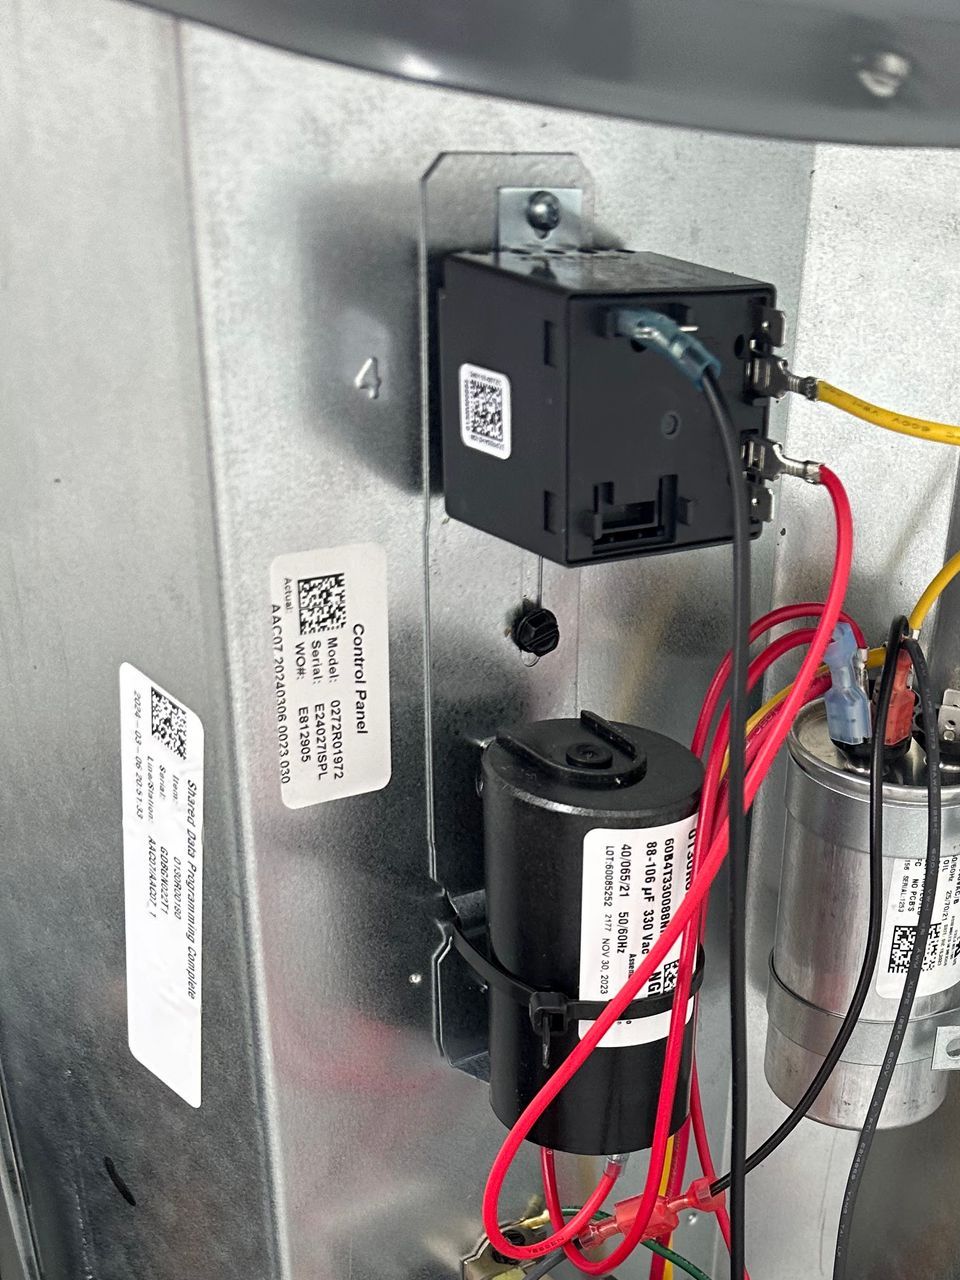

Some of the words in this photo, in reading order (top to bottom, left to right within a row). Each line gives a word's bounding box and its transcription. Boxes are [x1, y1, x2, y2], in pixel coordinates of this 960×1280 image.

[295, 642, 307, 680] WO#:
[311, 640, 323, 685] Serial:
[327, 637, 339, 684] Model:
[352, 623, 366, 684] Control
[355, 689, 368, 734] Panel
[299, 707, 311, 763] E812905
[330, 699, 344, 780] 0272R01972
[187, 779, 197, 827] Shared
[187, 829, 196, 858] Data
[645, 841, 657, 883] 88-106
[619, 844, 631, 897] 40/065/21
[911, 879, 918, 889] NO
[186, 861, 197, 944] Programming
[642, 910, 653, 930] 330
[601, 938, 610, 958] NOV
[617, 912, 628, 954] 50/60Hz
[642, 935, 653, 954] Vac
[186, 946, 197, 1000] Complete
[600, 975, 608, 994] 2023
